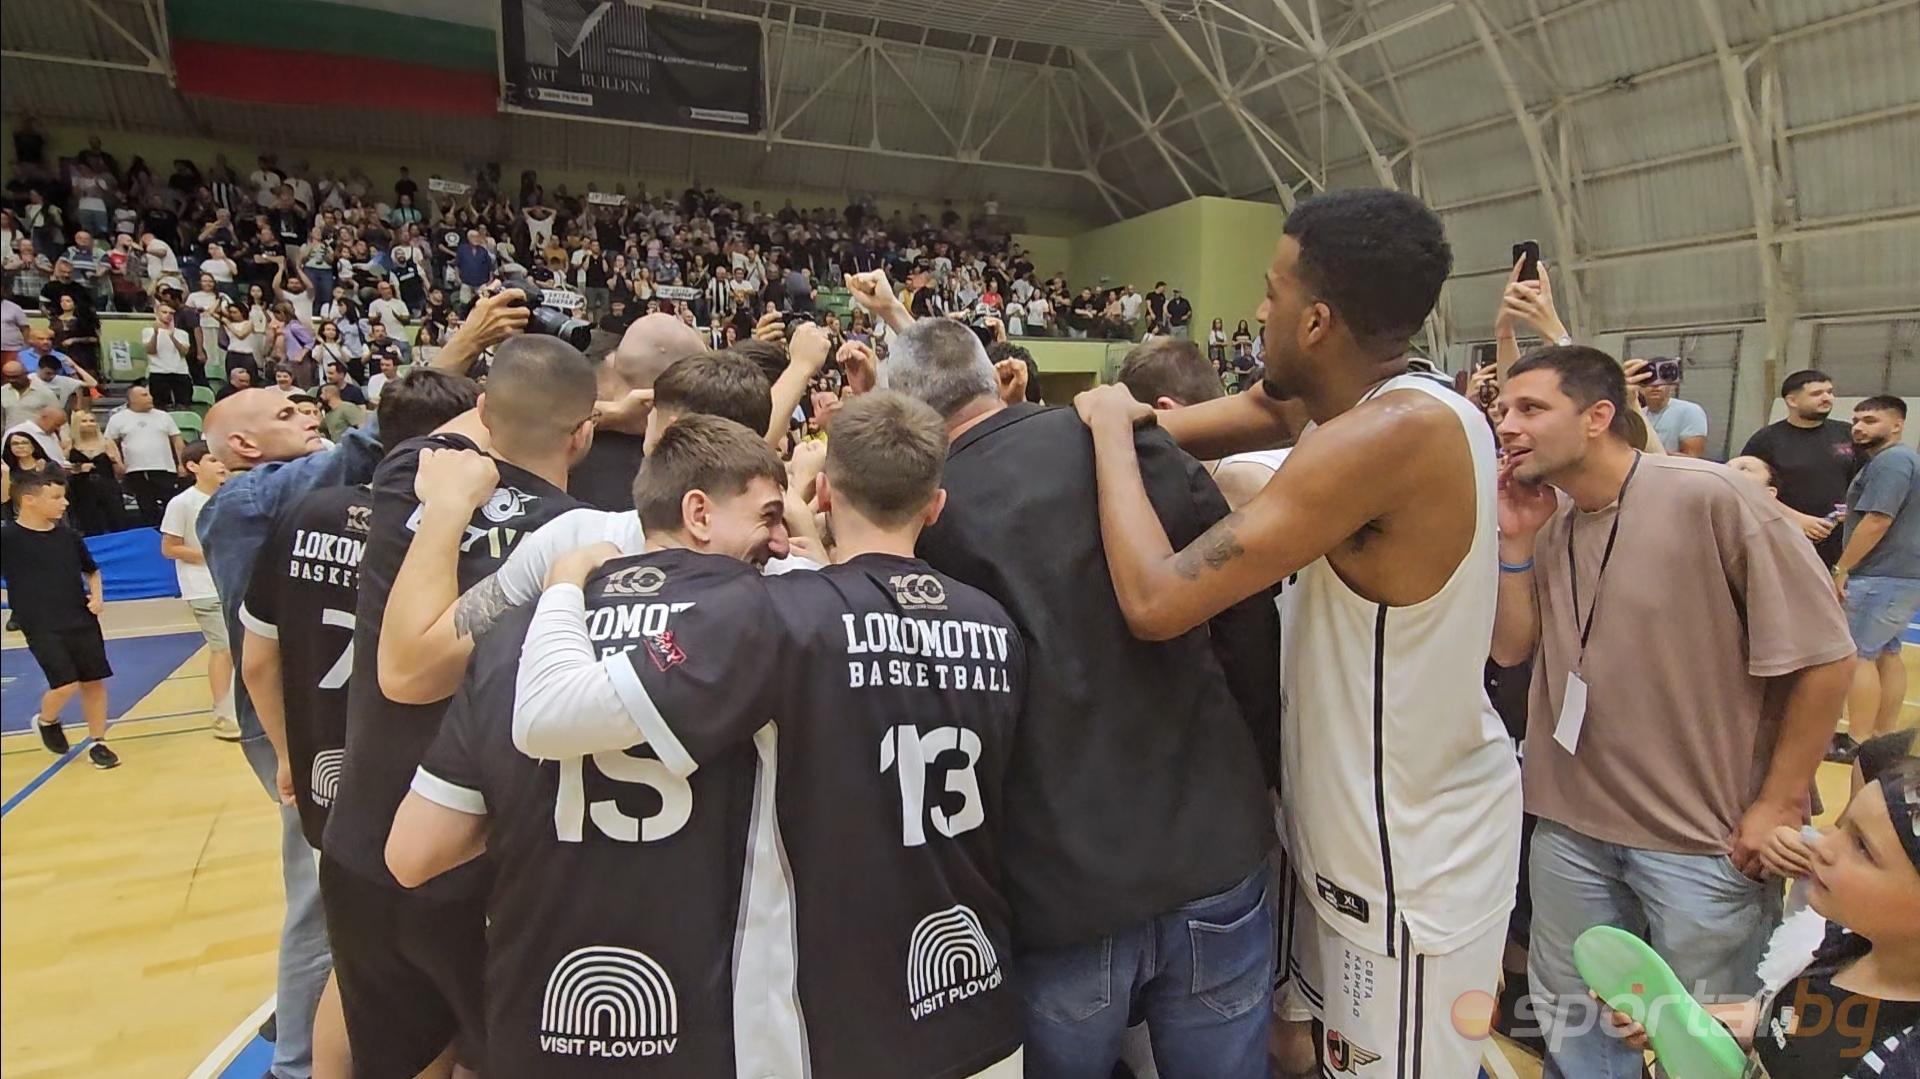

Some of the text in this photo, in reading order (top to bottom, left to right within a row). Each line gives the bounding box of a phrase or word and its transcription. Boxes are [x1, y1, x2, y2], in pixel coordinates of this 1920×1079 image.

[529, 66, 651, 95] ART BUILDING
[888, 573, 946, 605] 100
[842, 612, 1008, 663] LOKOMOTIV
[848, 659, 1011, 694] BASKETBALL
[879, 724, 985, 847] 13
[1343, 895, 1359, 909] XL
[910, 991, 947, 1022] VISIT
[540, 1034, 678, 1058] VISIT PLOVDIV
